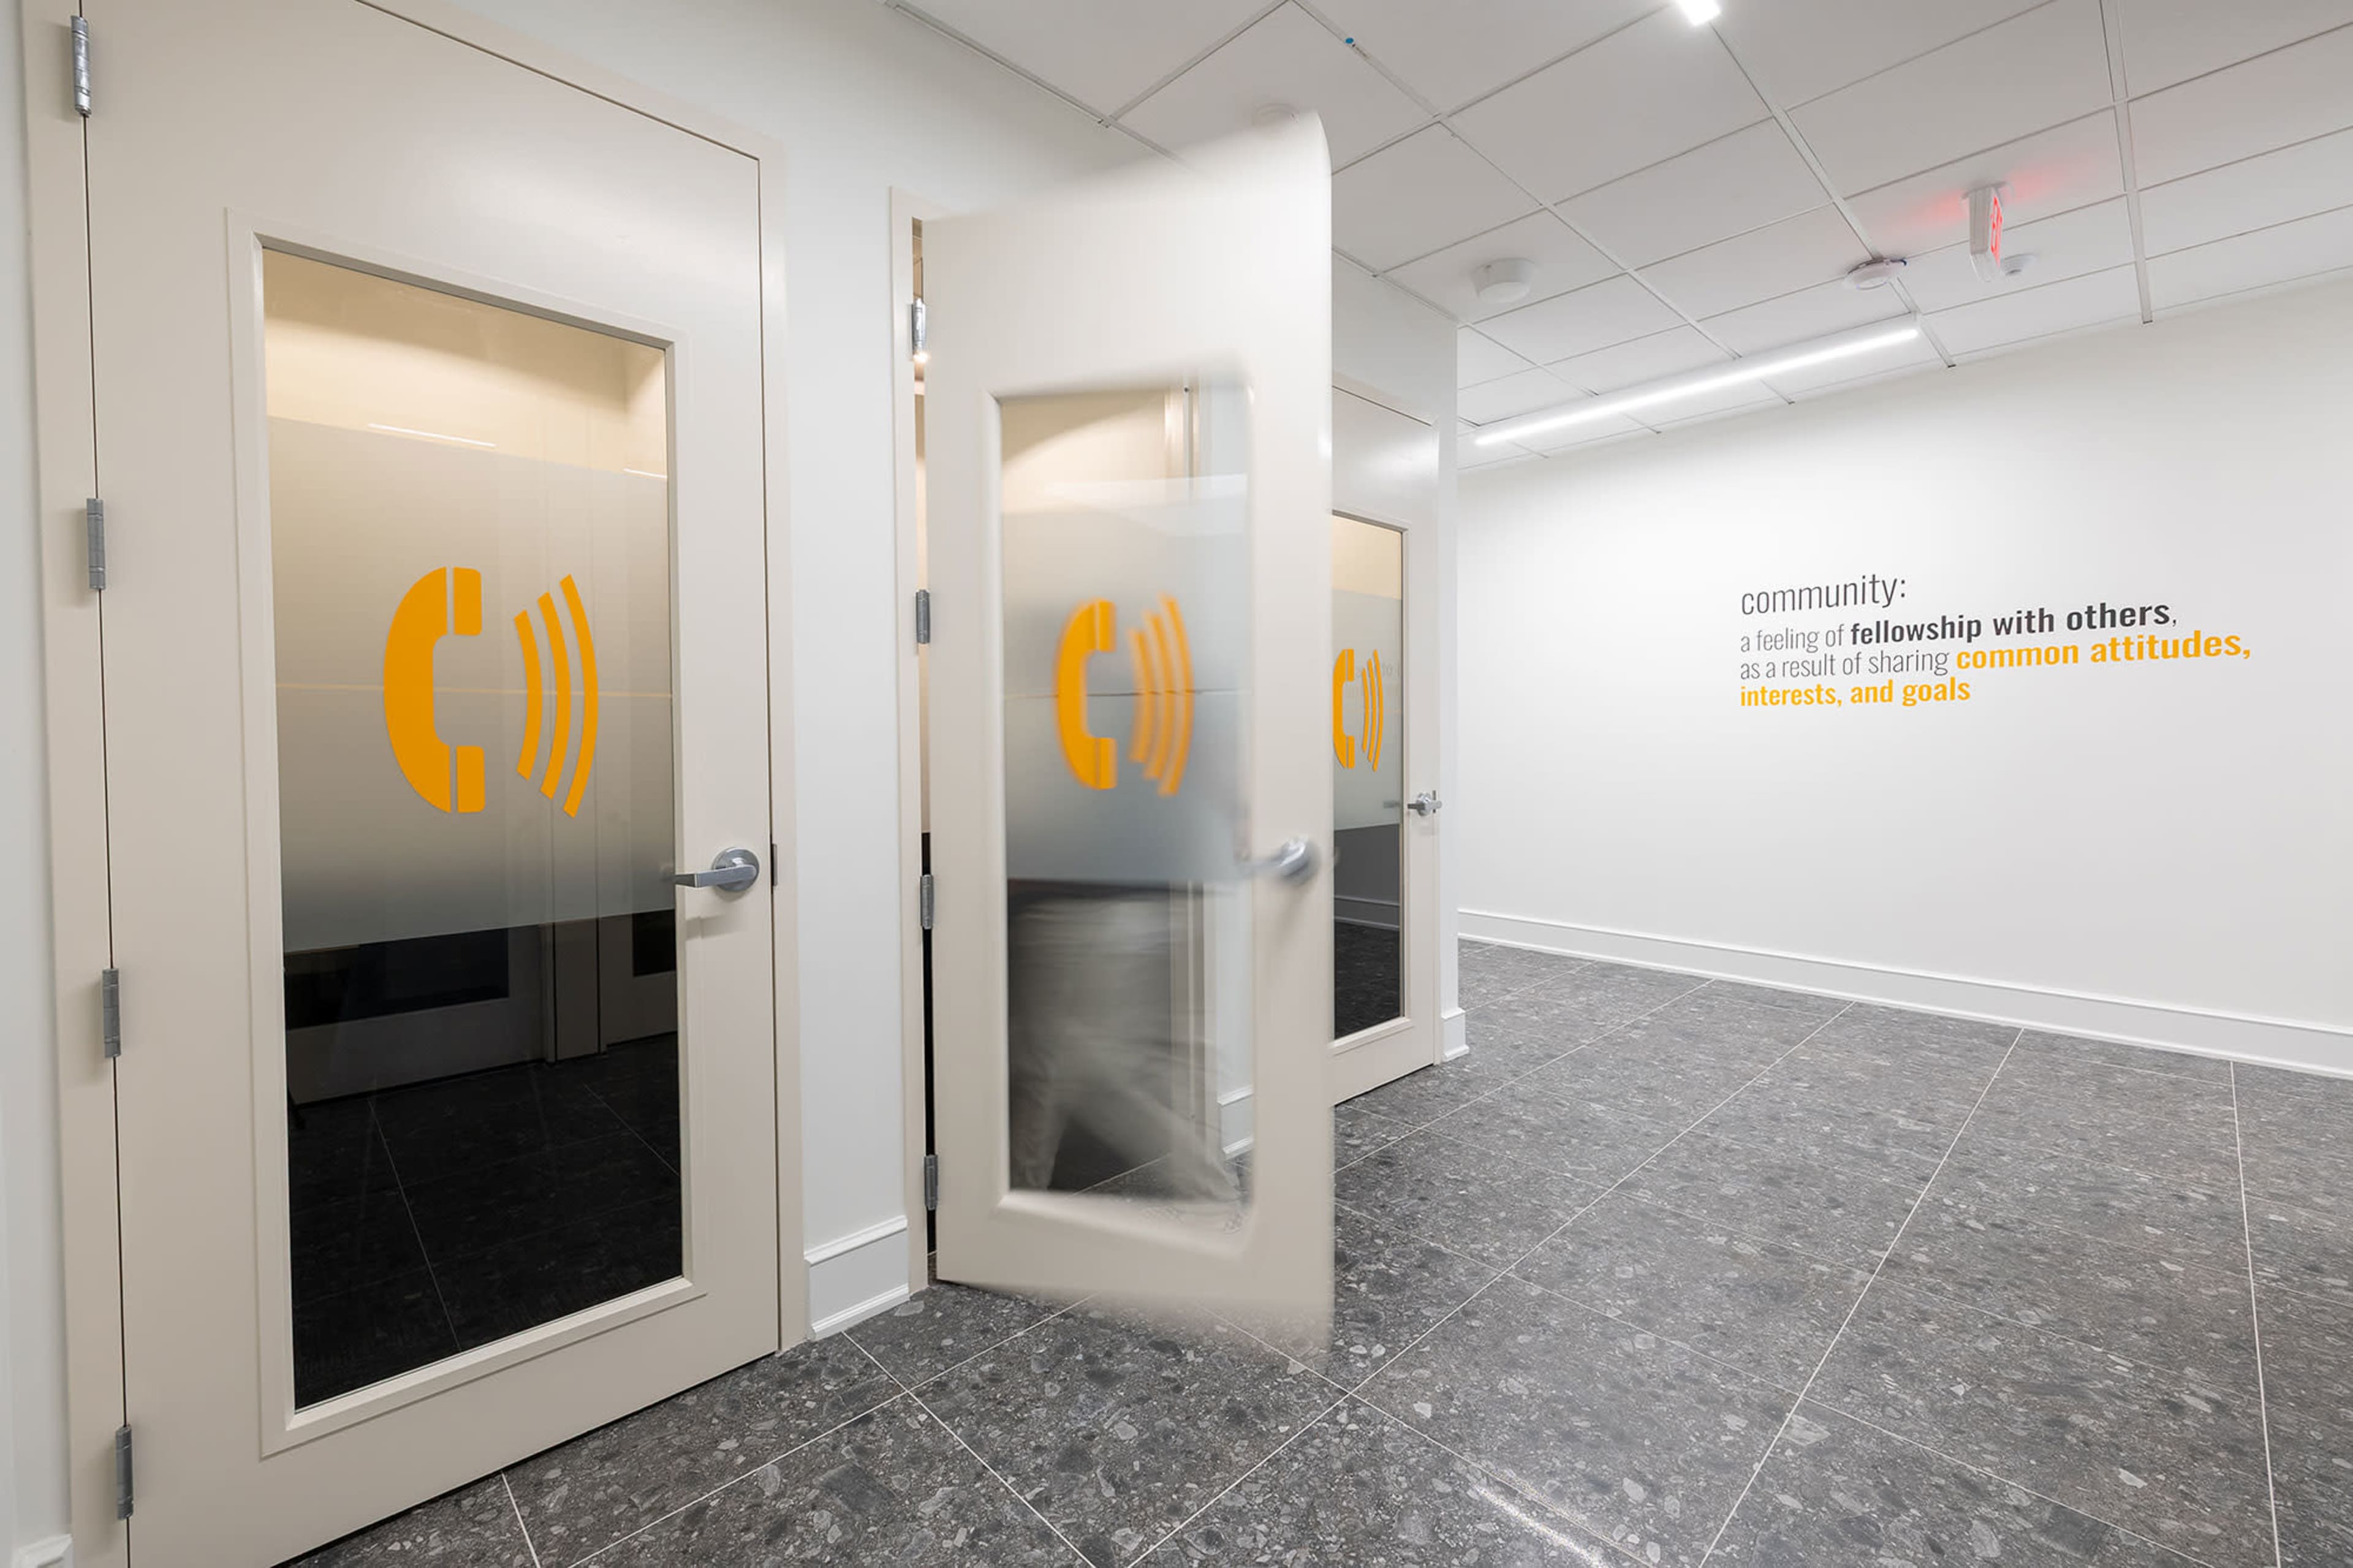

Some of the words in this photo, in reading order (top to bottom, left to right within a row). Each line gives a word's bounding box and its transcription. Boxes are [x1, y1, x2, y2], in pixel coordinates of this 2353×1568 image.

[1741, 574, 1906, 615] community:
[1740, 636, 1750, 653] a
[1757, 627, 1819, 653] feeling
[1825, 623, 1844, 648] of
[1850, 614, 1982, 646] fellowship
[1992, 607, 2055, 637] with
[2066, 602, 2177, 631] others,
[1740, 662, 1760, 680] as
[1765, 662, 1776, 678] a
[1782, 653, 1836, 678] result
[1843, 651, 1862, 676] of
[1868, 649, 1950, 676] sharing
[1955, 644, 2079, 670] common
[2090, 629, 2251, 664] attitudes,
[1740, 683, 1843, 708] interests,
[1849, 678, 1894, 705] and
[1901, 675, 1971, 707] goals
